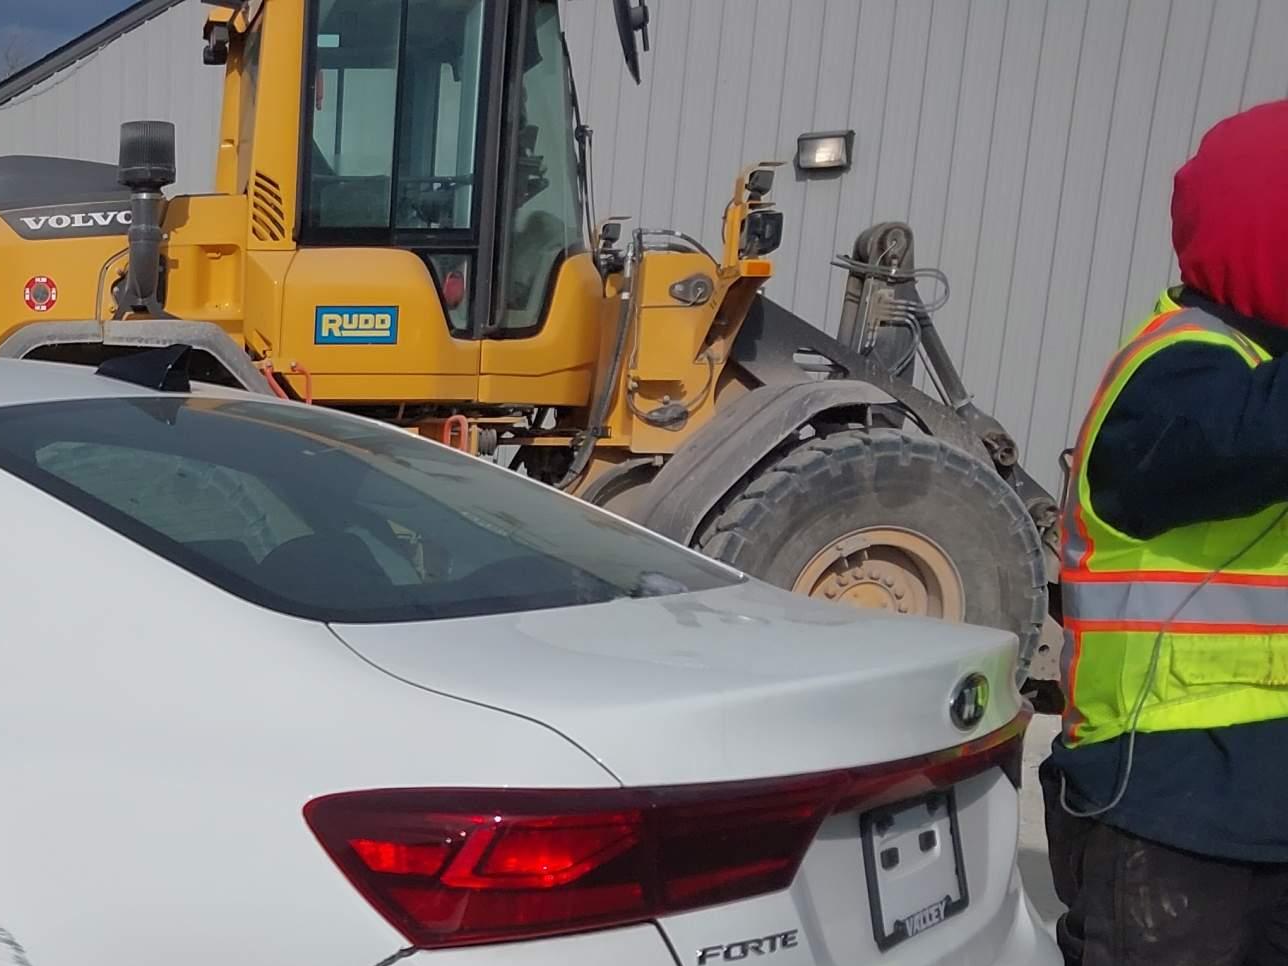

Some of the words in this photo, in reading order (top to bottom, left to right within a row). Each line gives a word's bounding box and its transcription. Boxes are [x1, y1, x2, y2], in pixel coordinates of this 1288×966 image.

[19, 209, 133, 230] VOLVO
[321, 313, 392, 337] RUDD
[904, 902, 947, 937] VALLEY
[696, 928, 799, 966] FORTE
